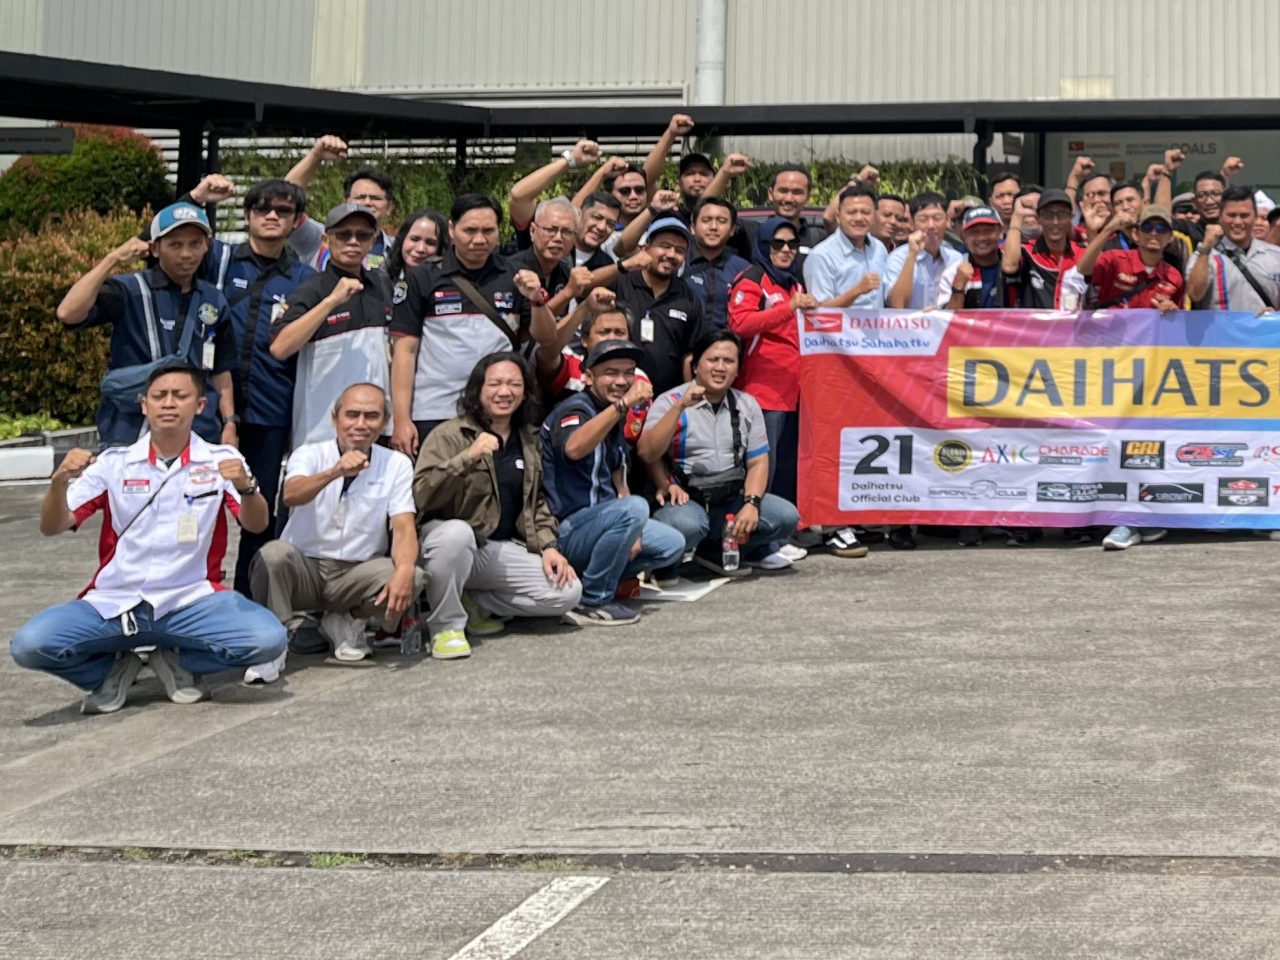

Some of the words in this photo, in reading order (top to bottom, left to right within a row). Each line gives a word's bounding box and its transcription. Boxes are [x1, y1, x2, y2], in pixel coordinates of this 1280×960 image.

[849, 316, 931, 331] DAIHATSU
[804, 336, 859, 349] Daihatsu
[853, 434, 914, 476] 21
[1038, 444, 1110, 457] CHARADE
[851, 482, 904, 491] Daihatsu
[851, 494, 892, 503] Official
[894, 494, 921, 503] Club
